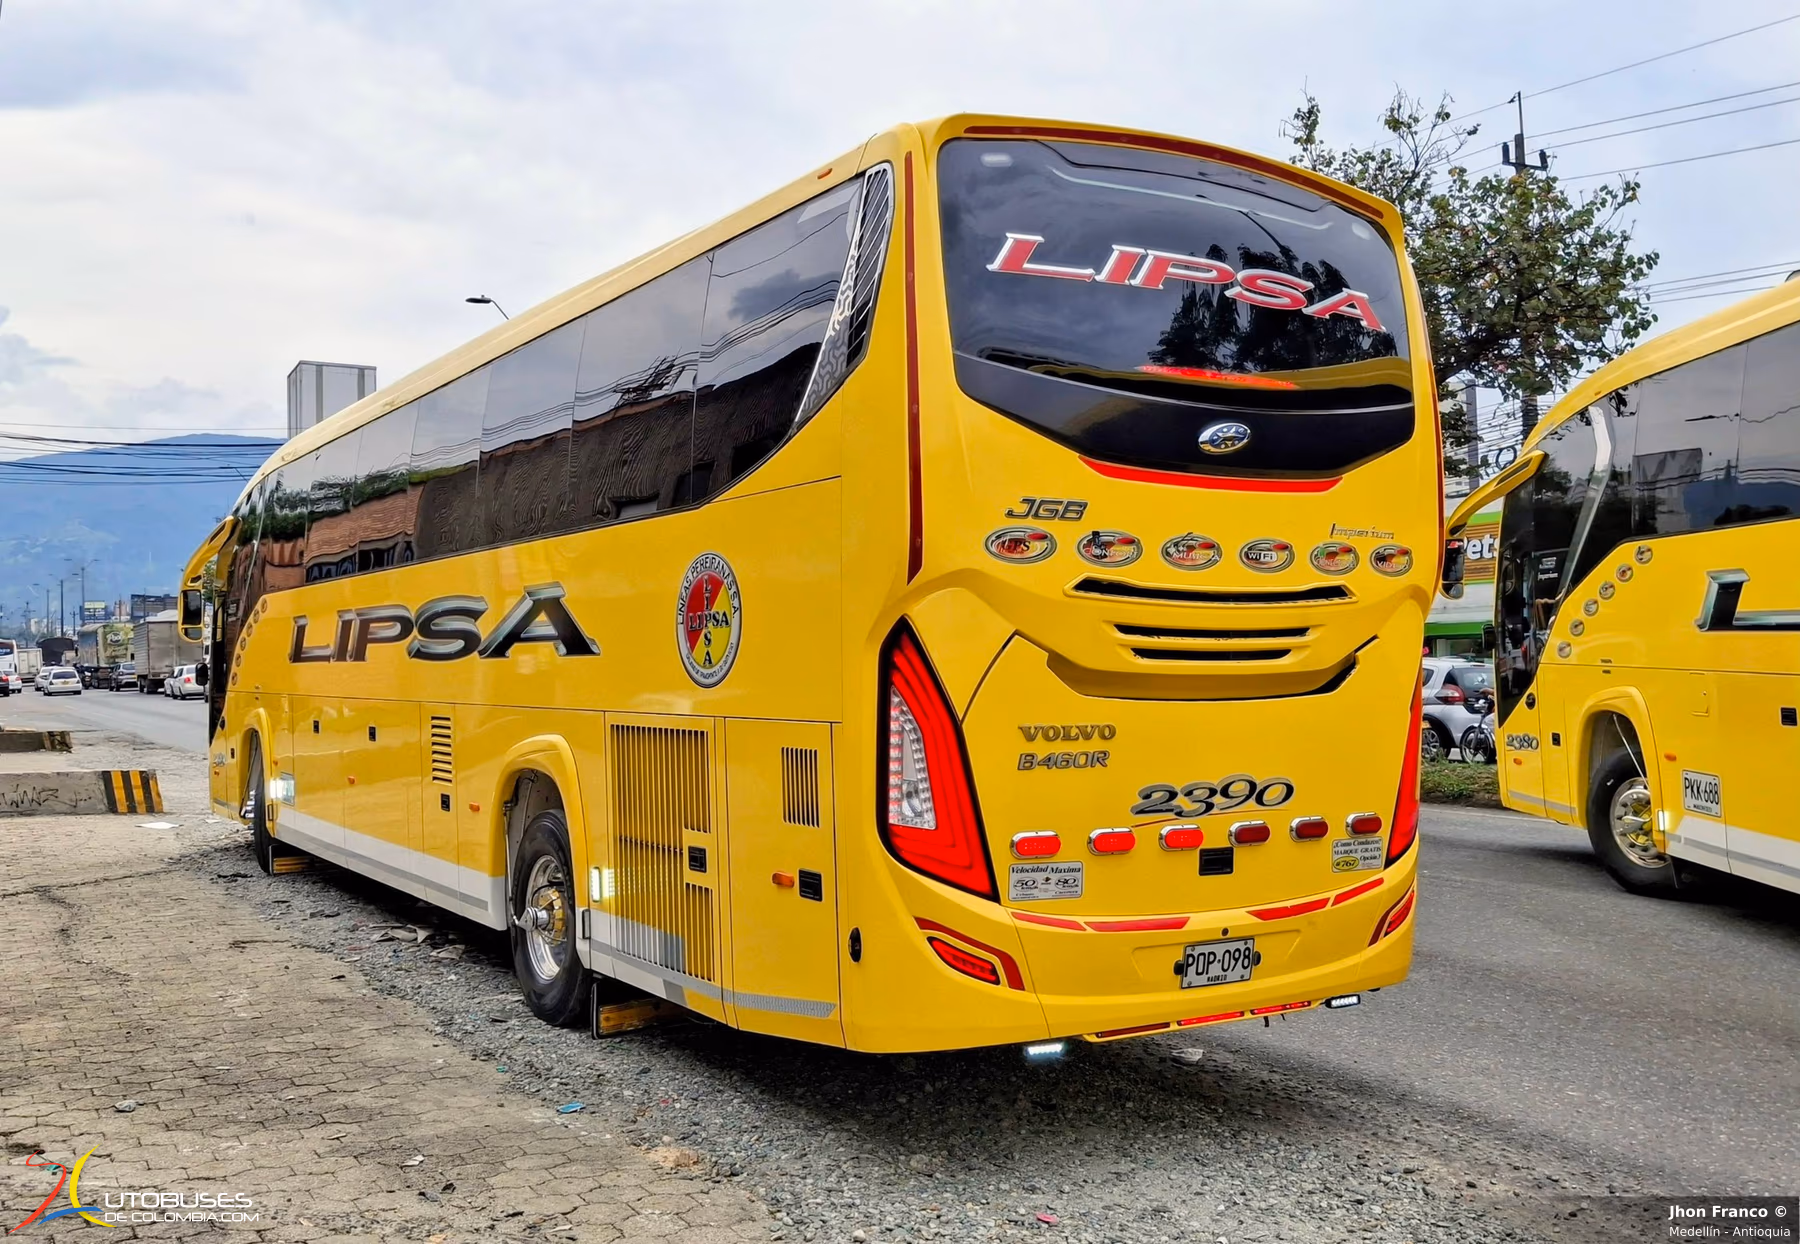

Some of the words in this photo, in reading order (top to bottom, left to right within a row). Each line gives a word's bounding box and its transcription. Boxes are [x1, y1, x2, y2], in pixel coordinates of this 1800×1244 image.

[986, 231, 1387, 333] LIPSA
[1004, 497, 1089, 521] JGB
[289, 580, 603, 664] LIPSA
[688, 610, 731, 631] LIPSA
[1018, 724, 1117, 742] VOLVO
[1017, 750, 1110, 771] B460R
[1130, 772, 1295, 819] 2390
[1011, 865, 1049, 874] Velocidad
[1014, 879, 1036, 888] 50
[1055, 877, 1077, 886] 80
